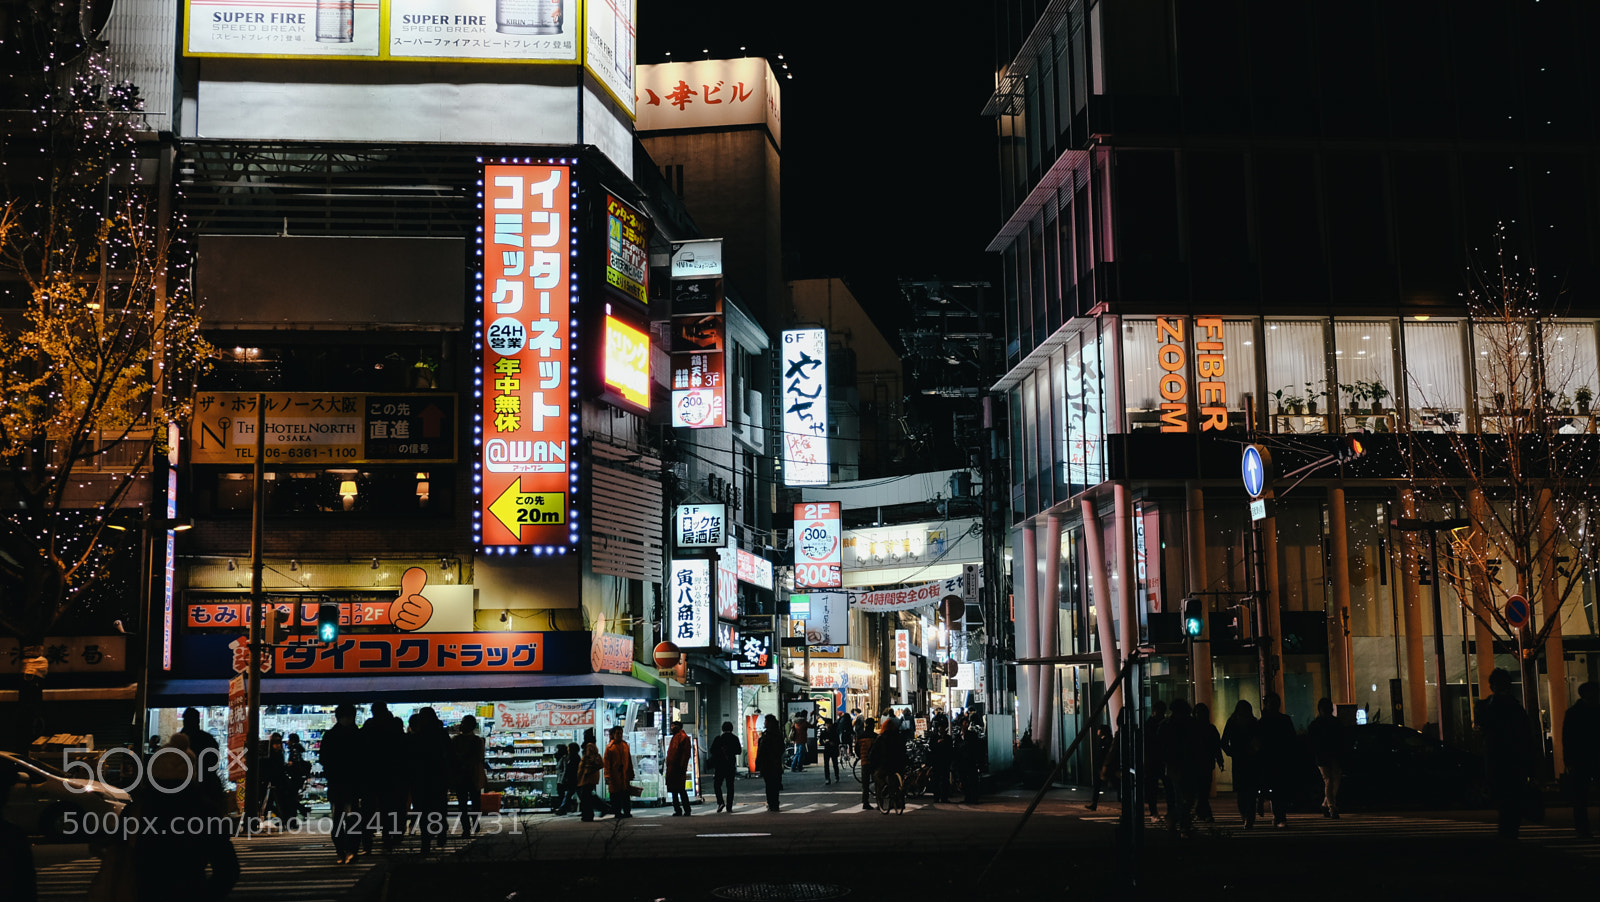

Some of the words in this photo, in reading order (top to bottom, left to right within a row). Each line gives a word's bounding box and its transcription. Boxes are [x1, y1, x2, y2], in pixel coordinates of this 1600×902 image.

[213, 12, 265, 23] SUPER
[271, 13, 306, 24] FIRE
[403, 15, 448, 25] SUPER
[455, 15, 486, 26] FIRE
[262, 24, 306, 32] BREAK
[394, 38, 572, 49] スーパーファイアスピードブレイク登場
[610, 218, 621, 241] 24
[491, 175, 524, 314] コミック
[530, 170, 561, 432] インターネット
[490, 325, 523, 337] 24H
[785, 333, 805, 343] 6F
[491, 338, 522, 349] 営業
[705, 375, 719, 386] 3F
[1157, 317, 1188, 432] ZOOM
[1197, 318, 1228, 431] FIBER
[493, 357, 521, 432] 年中無休
[370, 403, 410, 416] この先
[683, 397, 702, 408] 300
[264, 423, 308, 434] HOTEL
[308, 422, 356, 434] NORTH
[369, 420, 410, 439] 直進
[235, 448, 254, 457] TEL
[265, 448, 356, 458] 06-6361-1100
[487, 439, 566, 462] @WAN
[515, 496, 545, 506] この先
[516, 508, 560, 523] 20m
[804, 504, 830, 520] 2F
[682, 527, 720, 544] 居酒屋
[804, 527, 827, 540] 300
[860, 583, 940, 606] 24時間安全の街
[677, 568, 694, 639] 寅八商店
[365, 607, 384, 621] 2F
[282, 638, 538, 671] ダイコクドラッグ
[501, 712, 530, 728] 免税
[551, 711, 592, 725] 8%OFF
